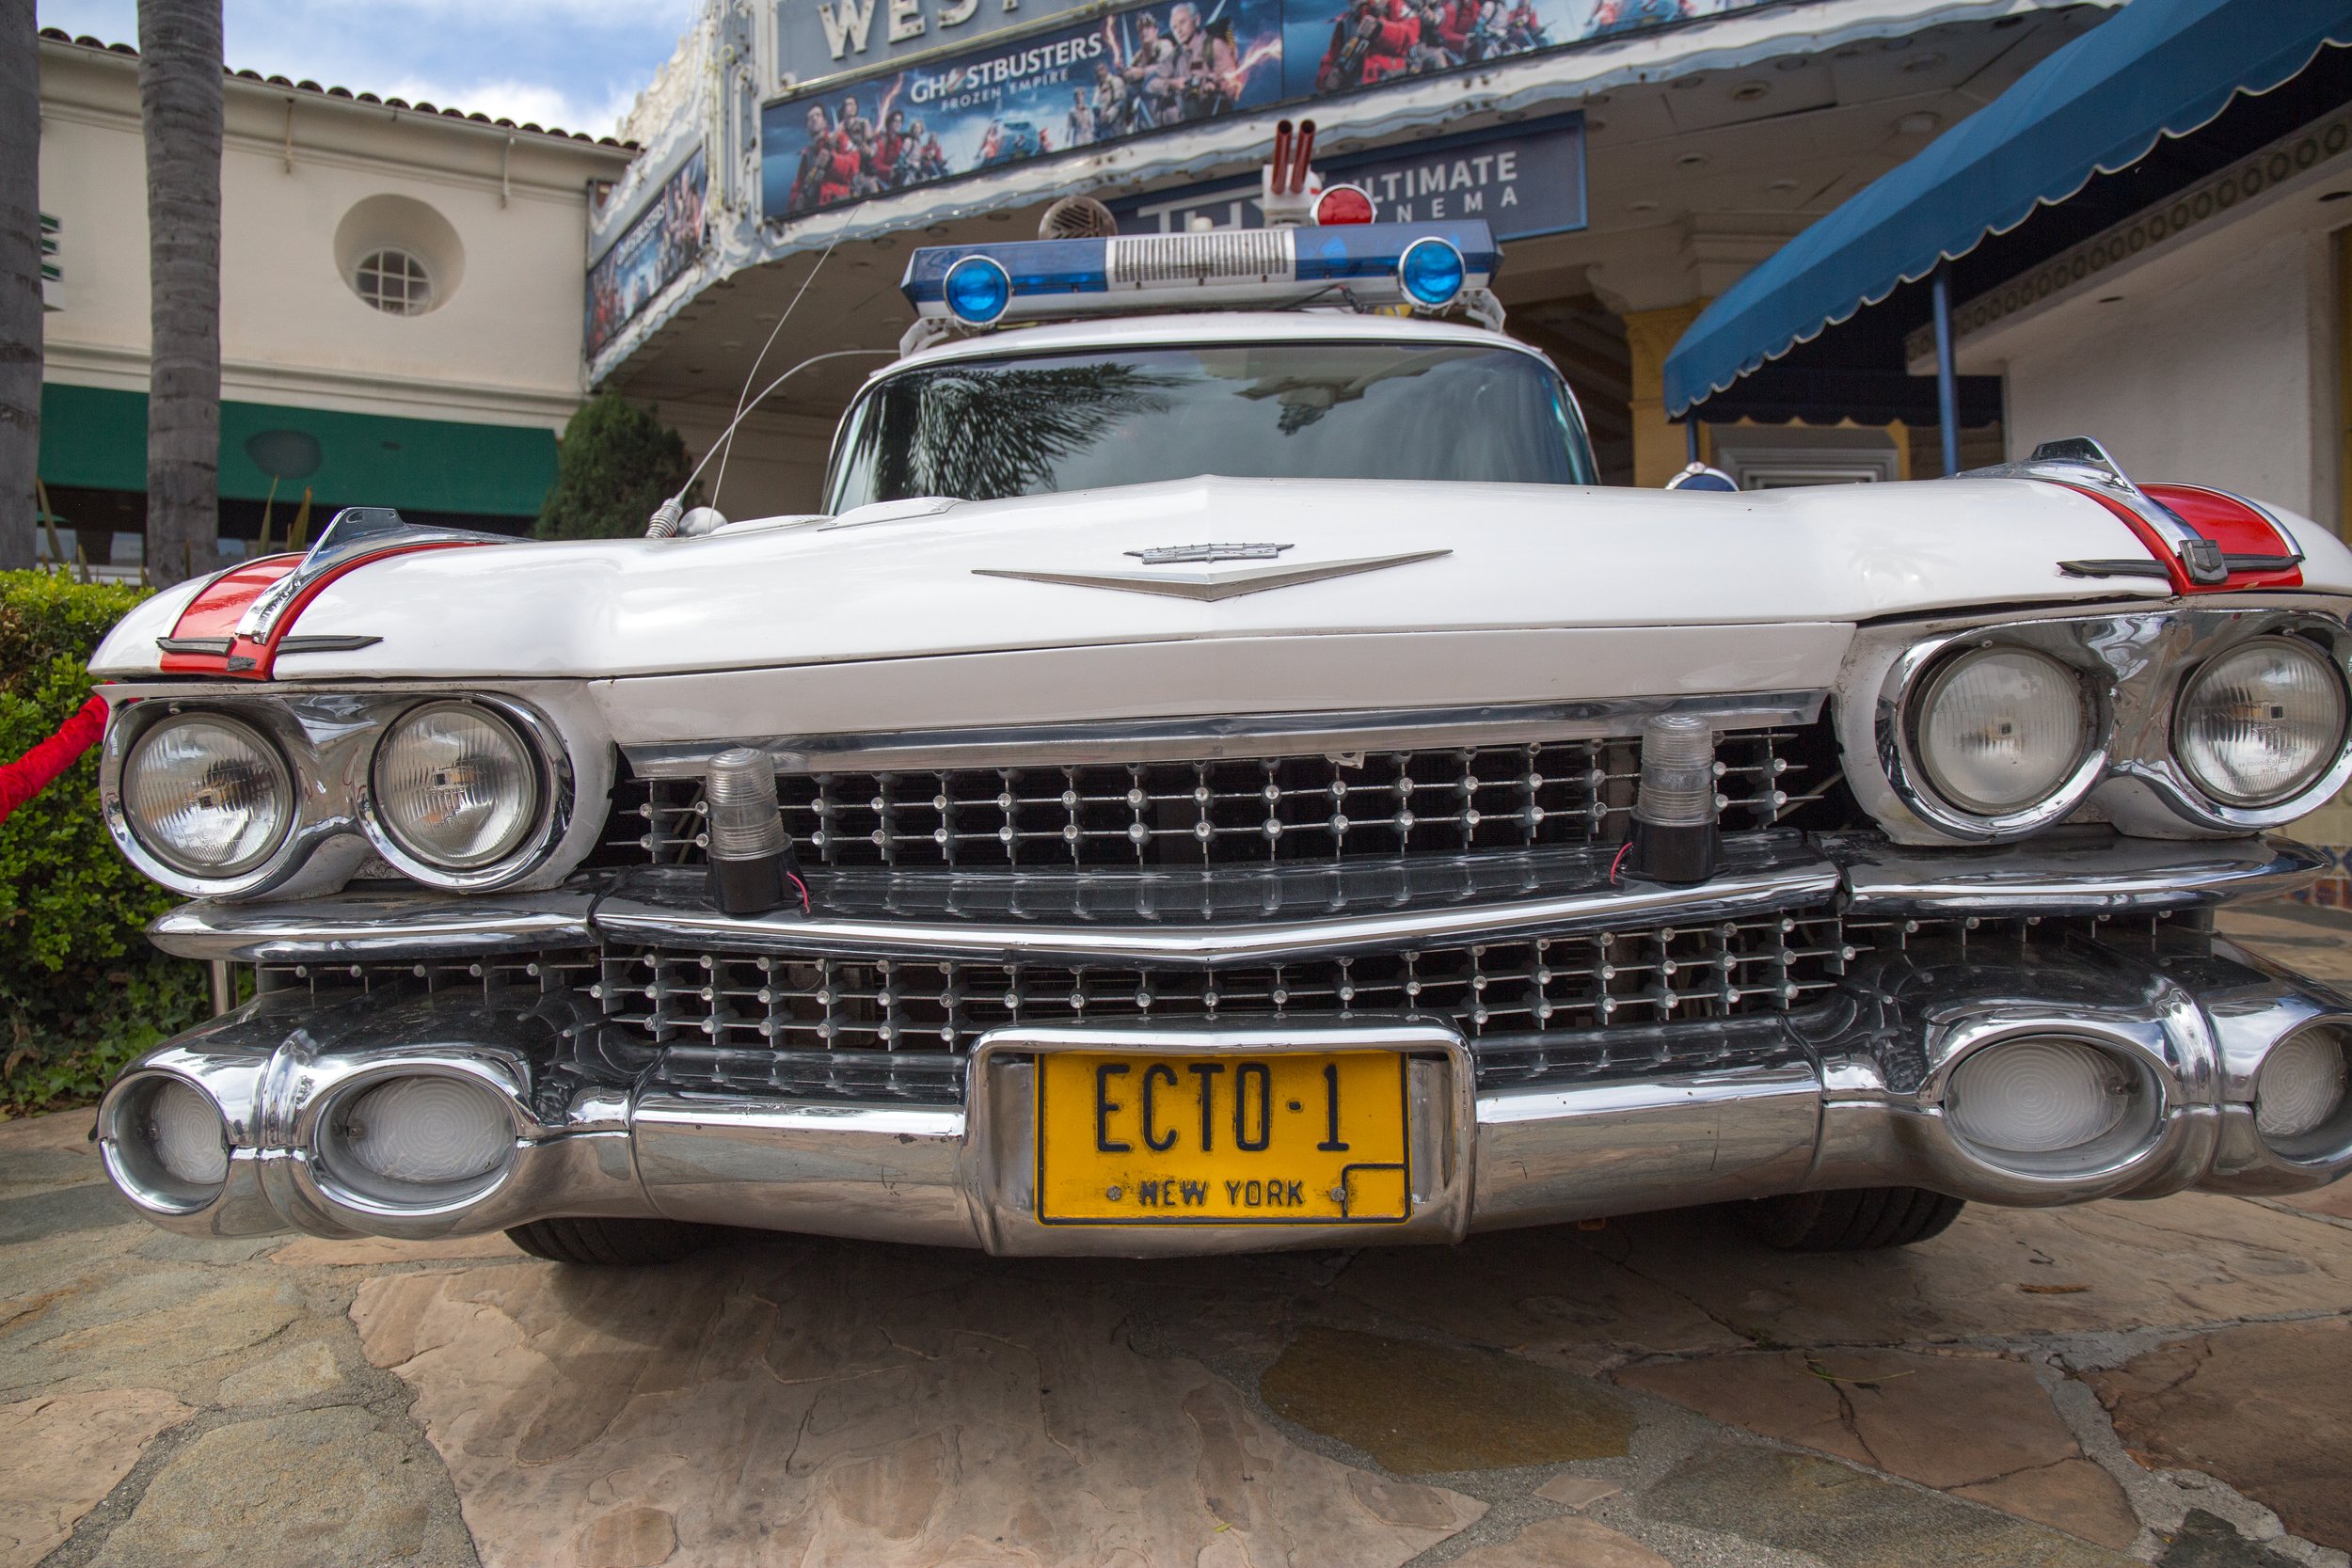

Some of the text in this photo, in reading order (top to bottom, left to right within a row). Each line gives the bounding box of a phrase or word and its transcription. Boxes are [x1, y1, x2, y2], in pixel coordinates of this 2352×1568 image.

[941, 68, 1069, 112] FROZEN EMPIRE
[1342, 151, 1518, 204] LTIMATE
[1096, 1062, 1350, 1152] ECTO-1
[1140, 1180, 1305, 1207] NEW YORK
